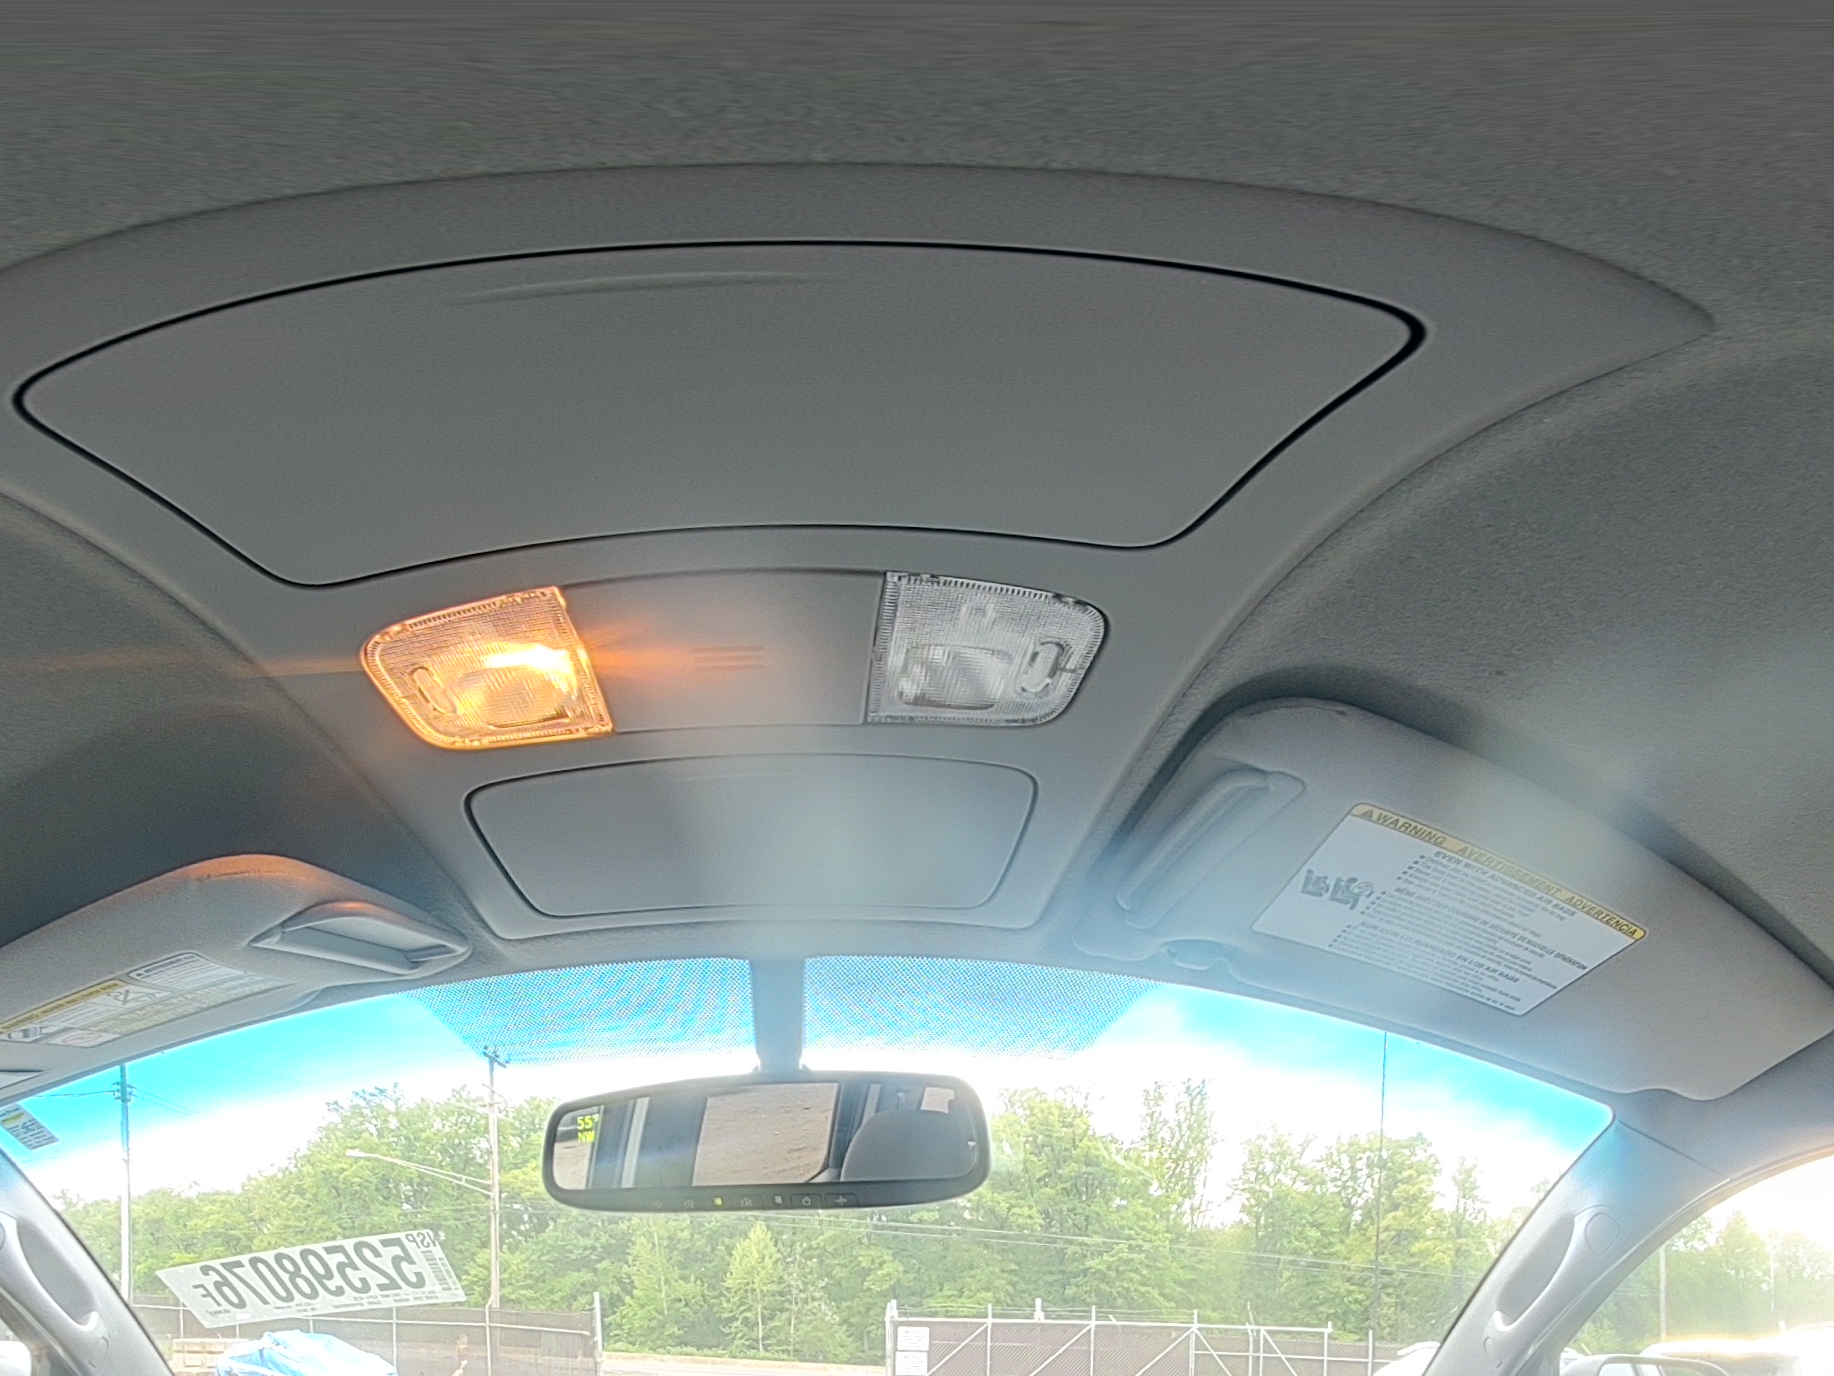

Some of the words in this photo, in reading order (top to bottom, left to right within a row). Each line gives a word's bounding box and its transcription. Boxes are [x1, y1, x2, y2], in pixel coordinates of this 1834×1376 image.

[1374, 811, 1447, 847] WARNING
[1456, 845, 1563, 896] AVERTISSEMENT
[1565, 895, 1637, 937] ADVERTENCIA
[1433, 850, 1463, 865] EVEN
[1552, 903, 1576, 916] BAGS
[578, 1130, 595, 1143] NW
